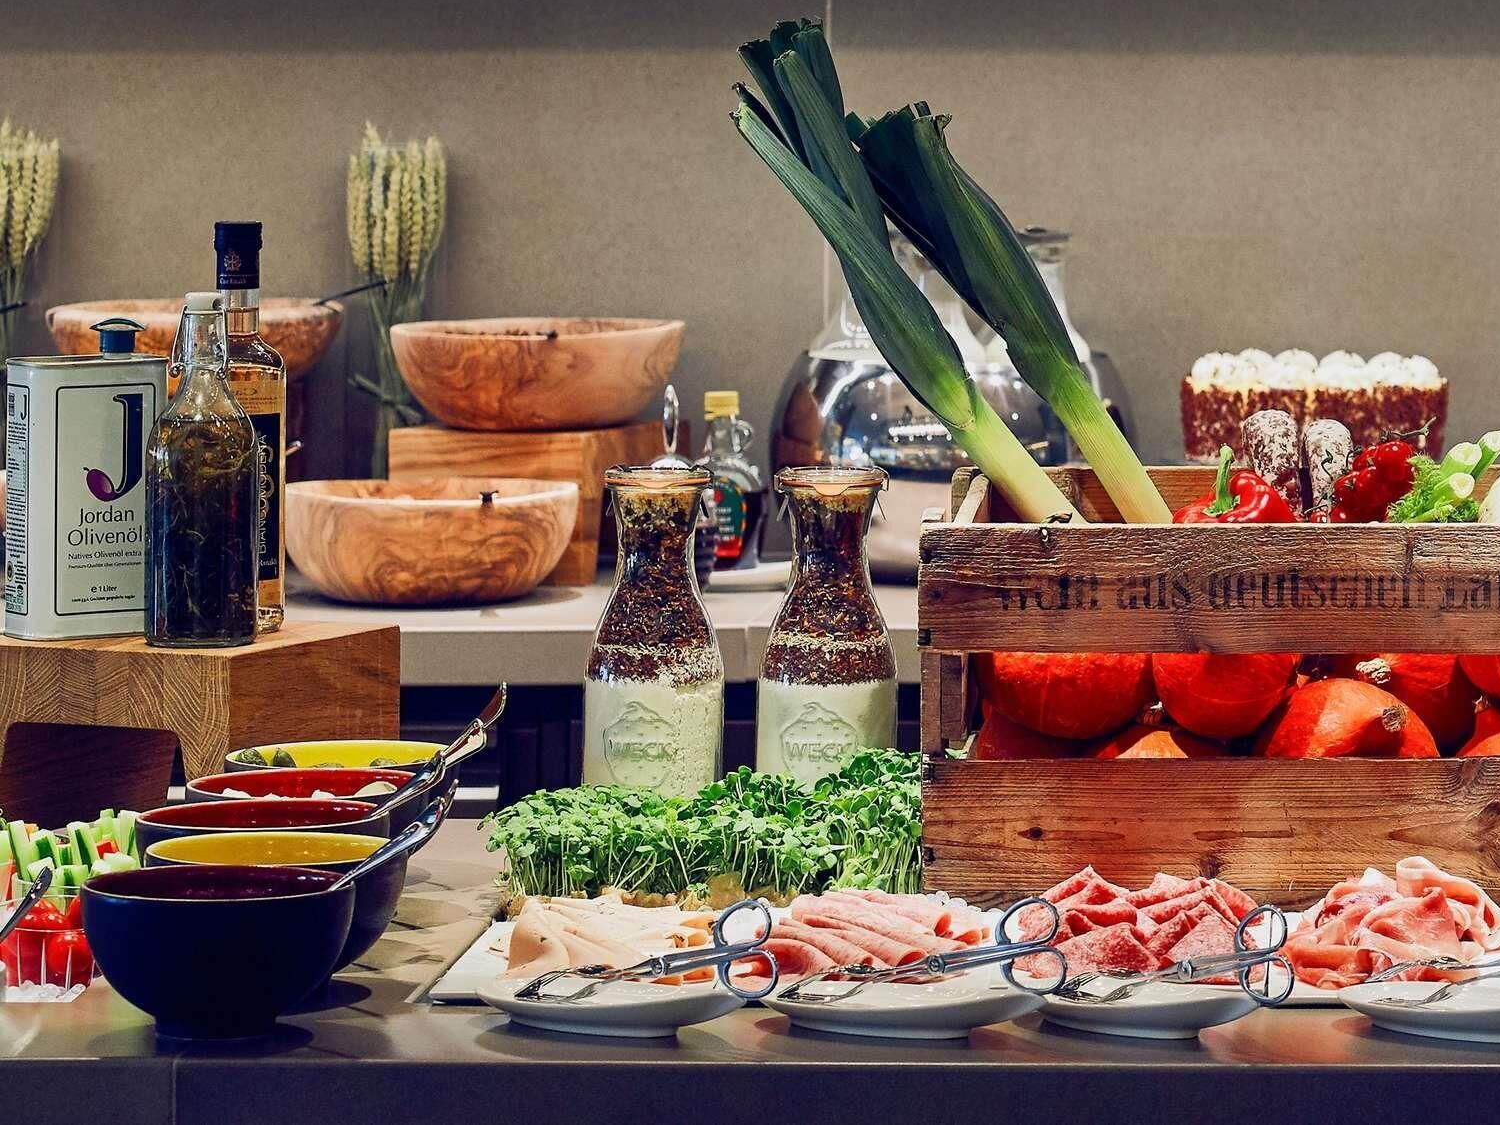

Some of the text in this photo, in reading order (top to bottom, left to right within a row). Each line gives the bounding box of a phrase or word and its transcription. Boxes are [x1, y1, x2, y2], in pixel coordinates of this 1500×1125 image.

[78, 504, 135, 528] Jordan
[67, 524, 143, 546] Olivenöl
[94, 549, 124, 559] Olivenöl
[608, 739, 674, 763] WECK
